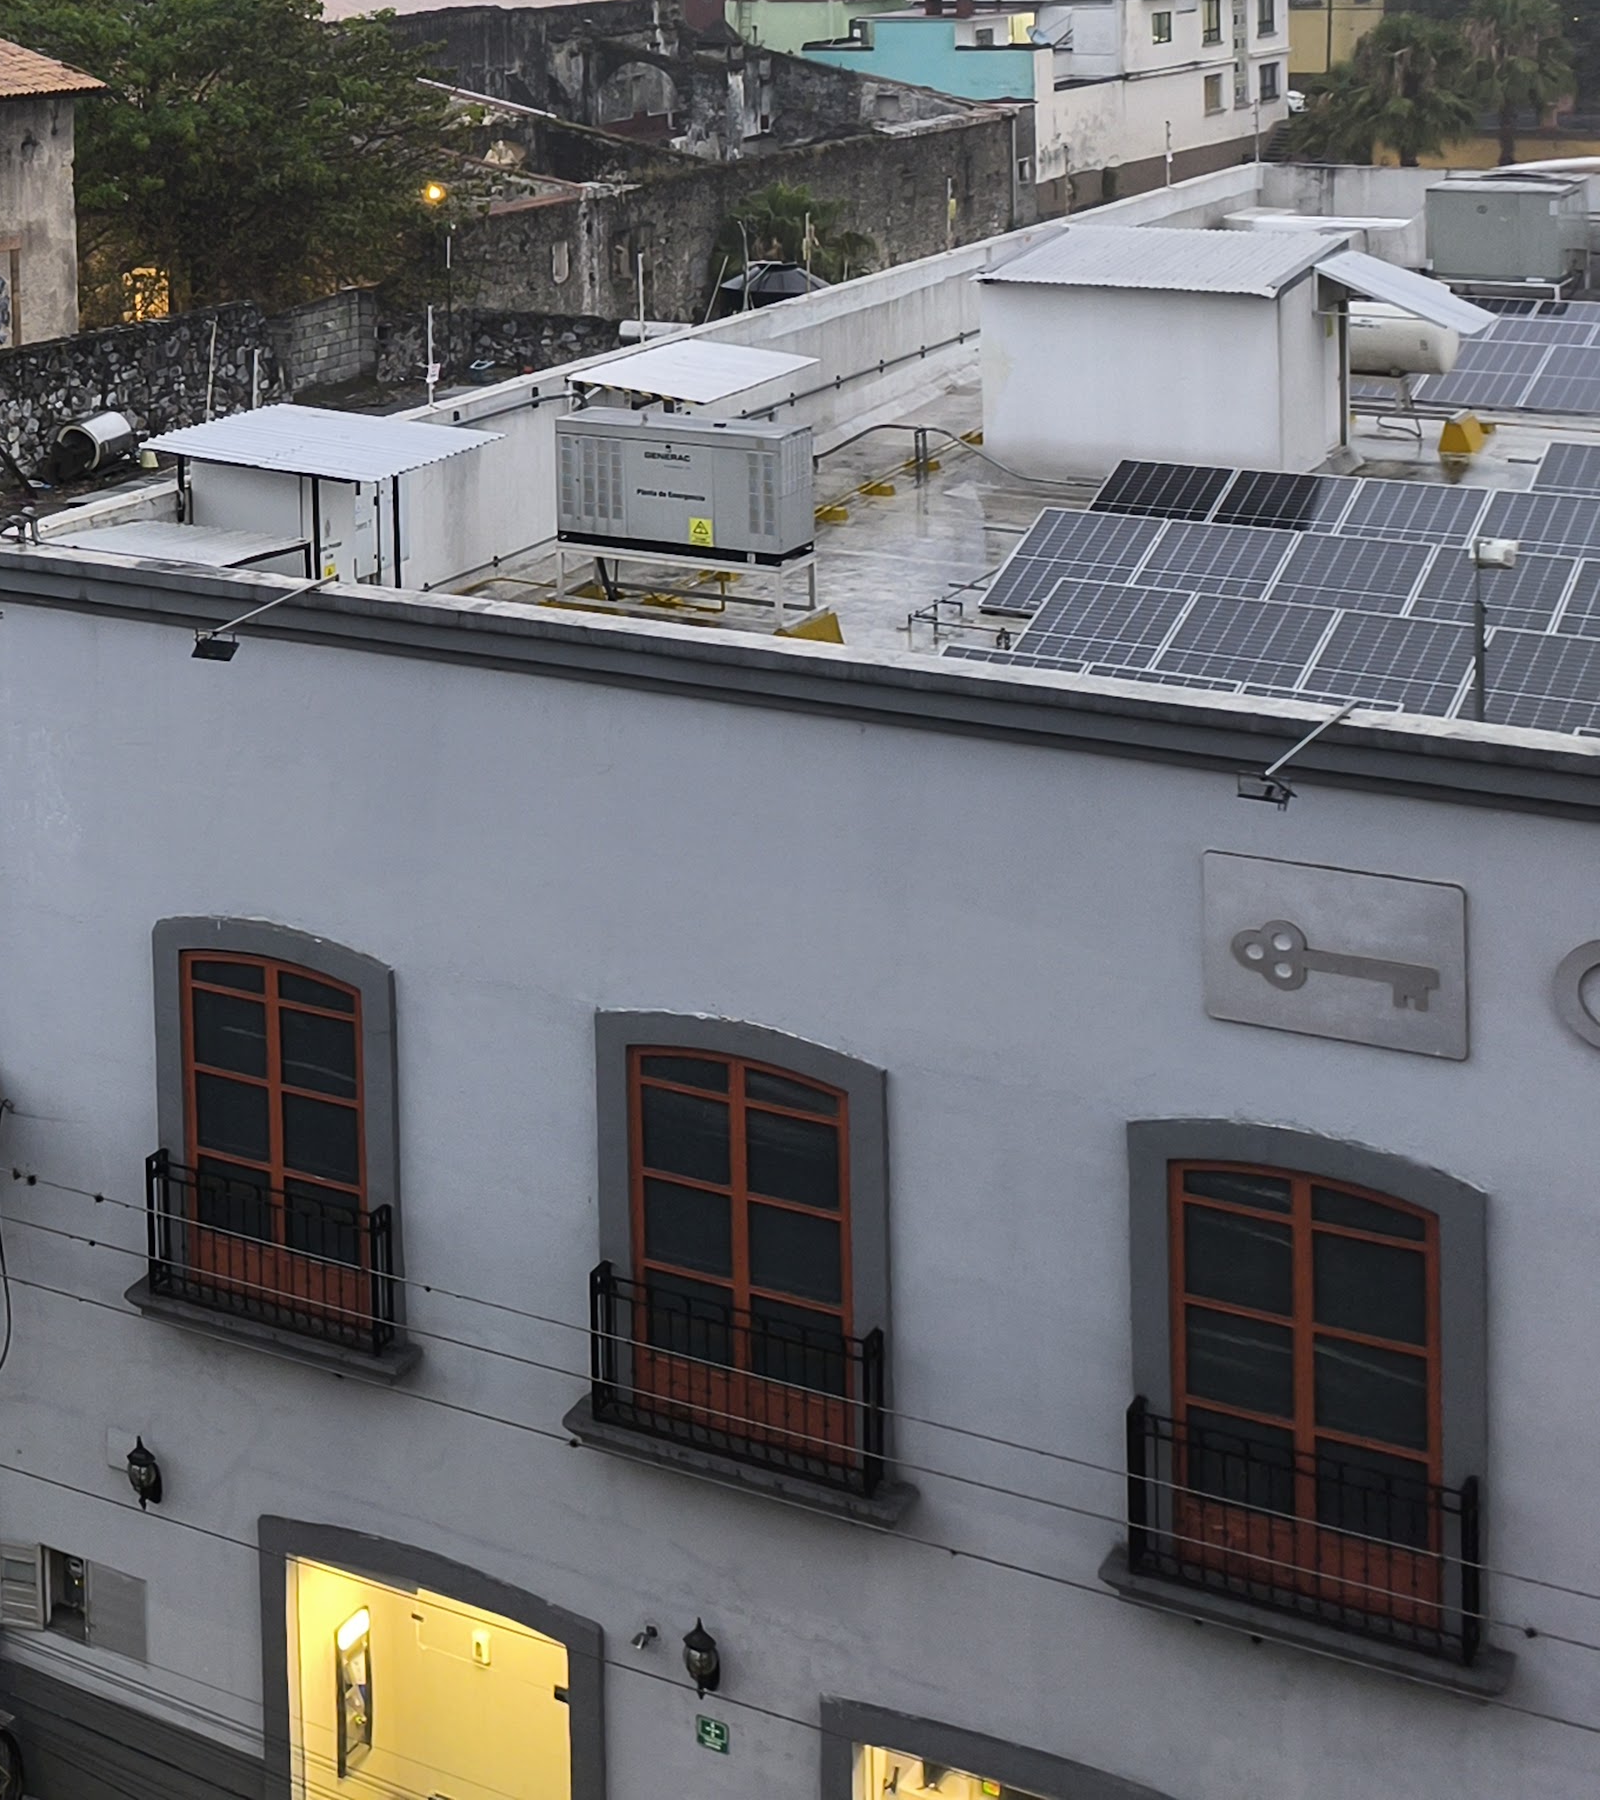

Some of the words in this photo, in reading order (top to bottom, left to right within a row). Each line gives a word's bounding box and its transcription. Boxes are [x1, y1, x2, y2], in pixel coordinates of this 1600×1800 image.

[644, 451, 691, 463] GENERAC
[636, 488, 657, 497] Planta
[668, 491, 706, 502] Emergencia
